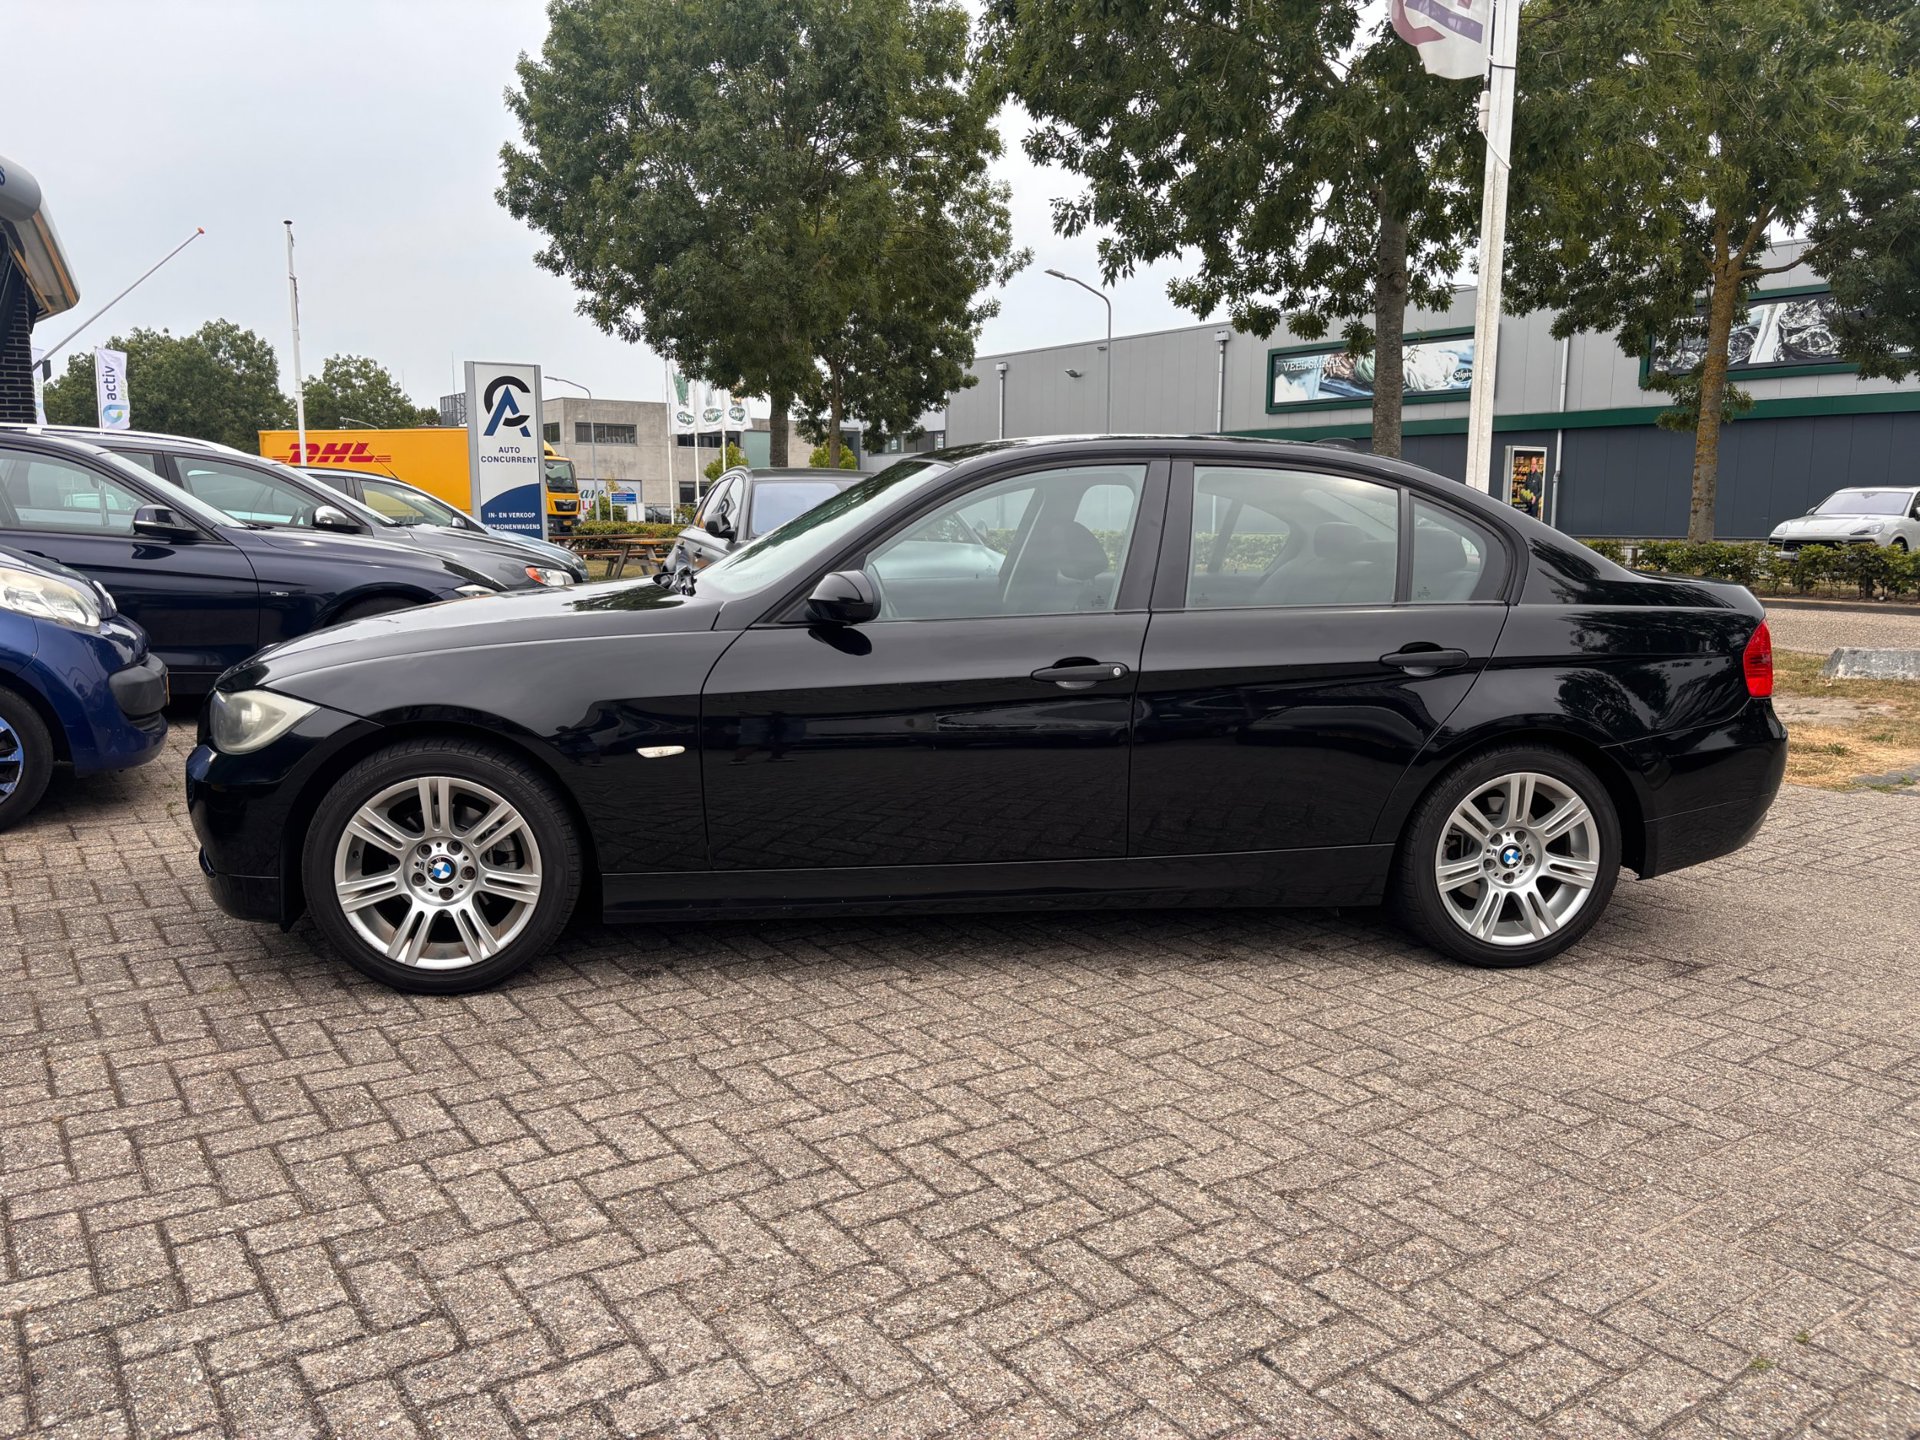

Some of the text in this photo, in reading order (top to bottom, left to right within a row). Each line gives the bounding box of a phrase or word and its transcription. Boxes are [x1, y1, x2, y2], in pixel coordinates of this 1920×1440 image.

[102, 365, 117, 401] activ
[288, 442, 375, 463] DHL
[480, 455, 537, 463] CONCURRENT
